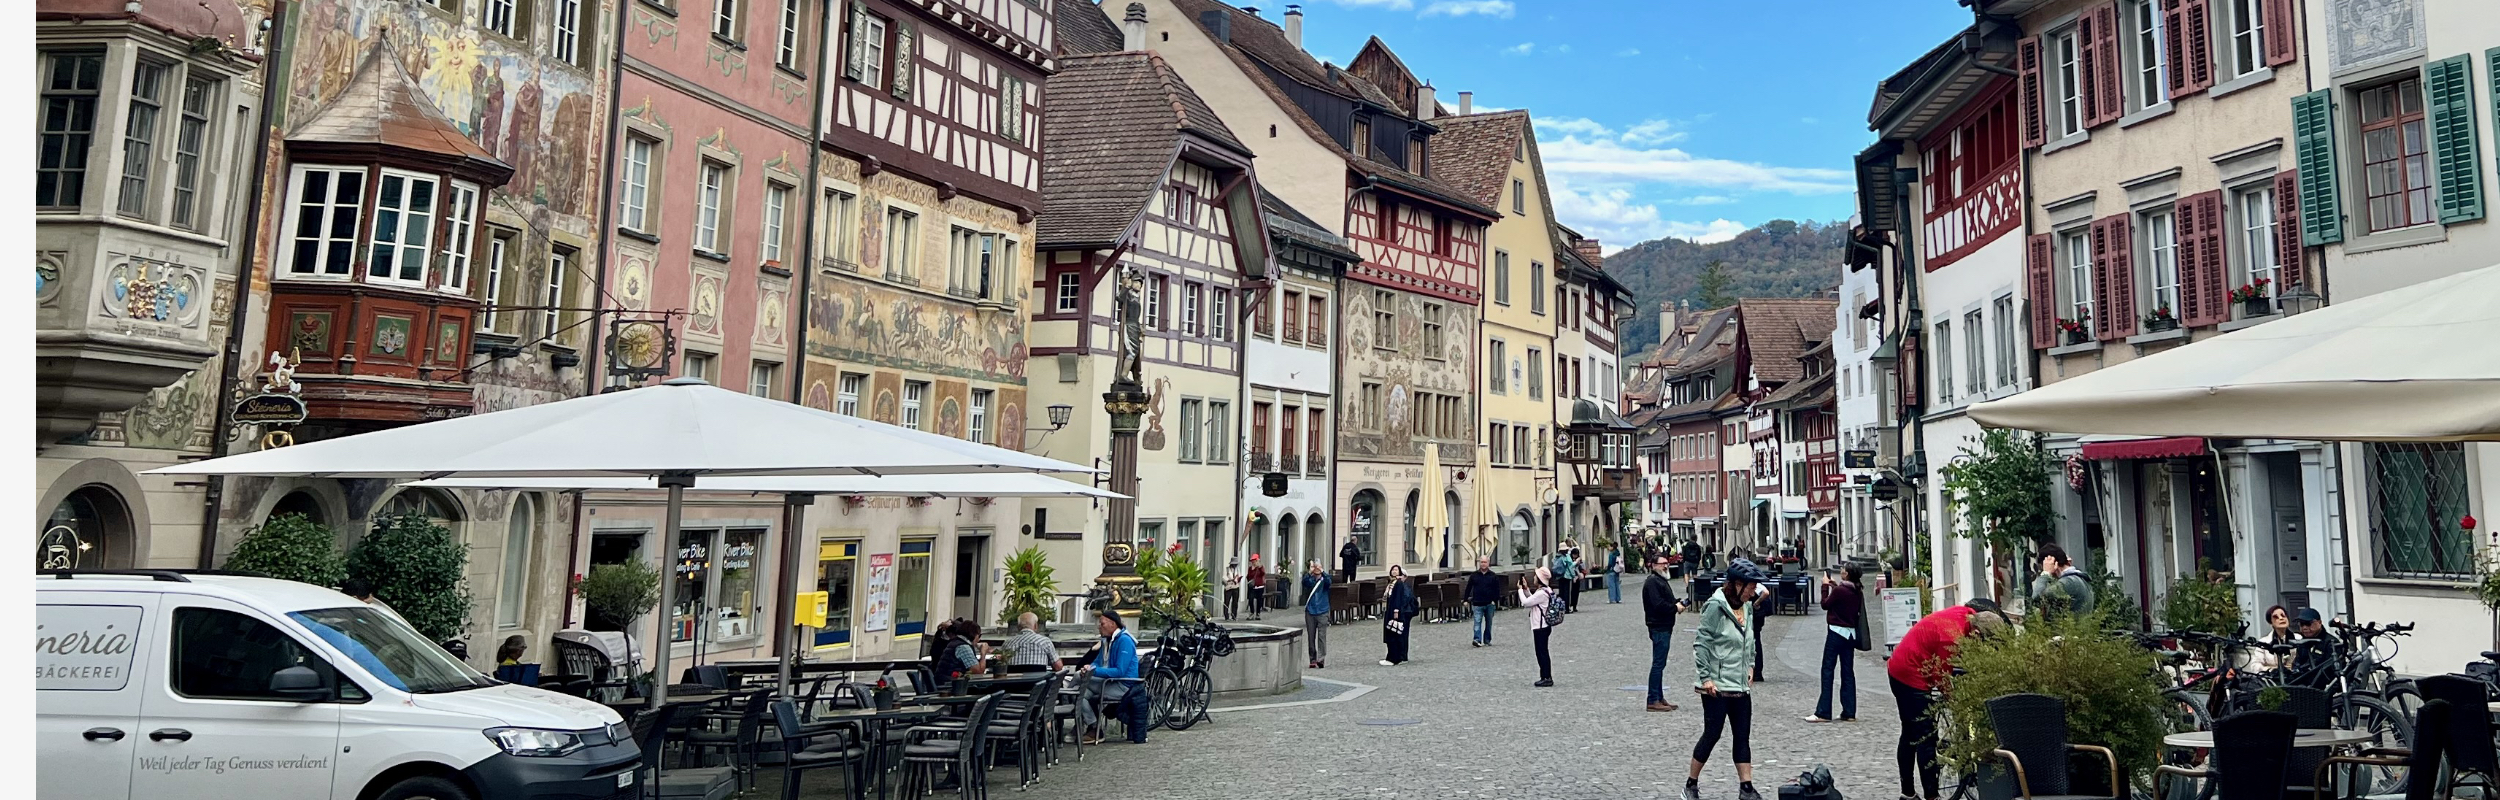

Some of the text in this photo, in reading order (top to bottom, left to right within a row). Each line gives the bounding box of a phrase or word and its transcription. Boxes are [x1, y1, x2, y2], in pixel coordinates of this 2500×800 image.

[247, 400, 293, 414] Steineria
[678, 543, 706, 559] ver Bike
[723, 542, 755, 557] River Bike
[36, 624, 131, 655] neria
[139, 754, 328, 775] Weil jeder Tag Genuss verdient
